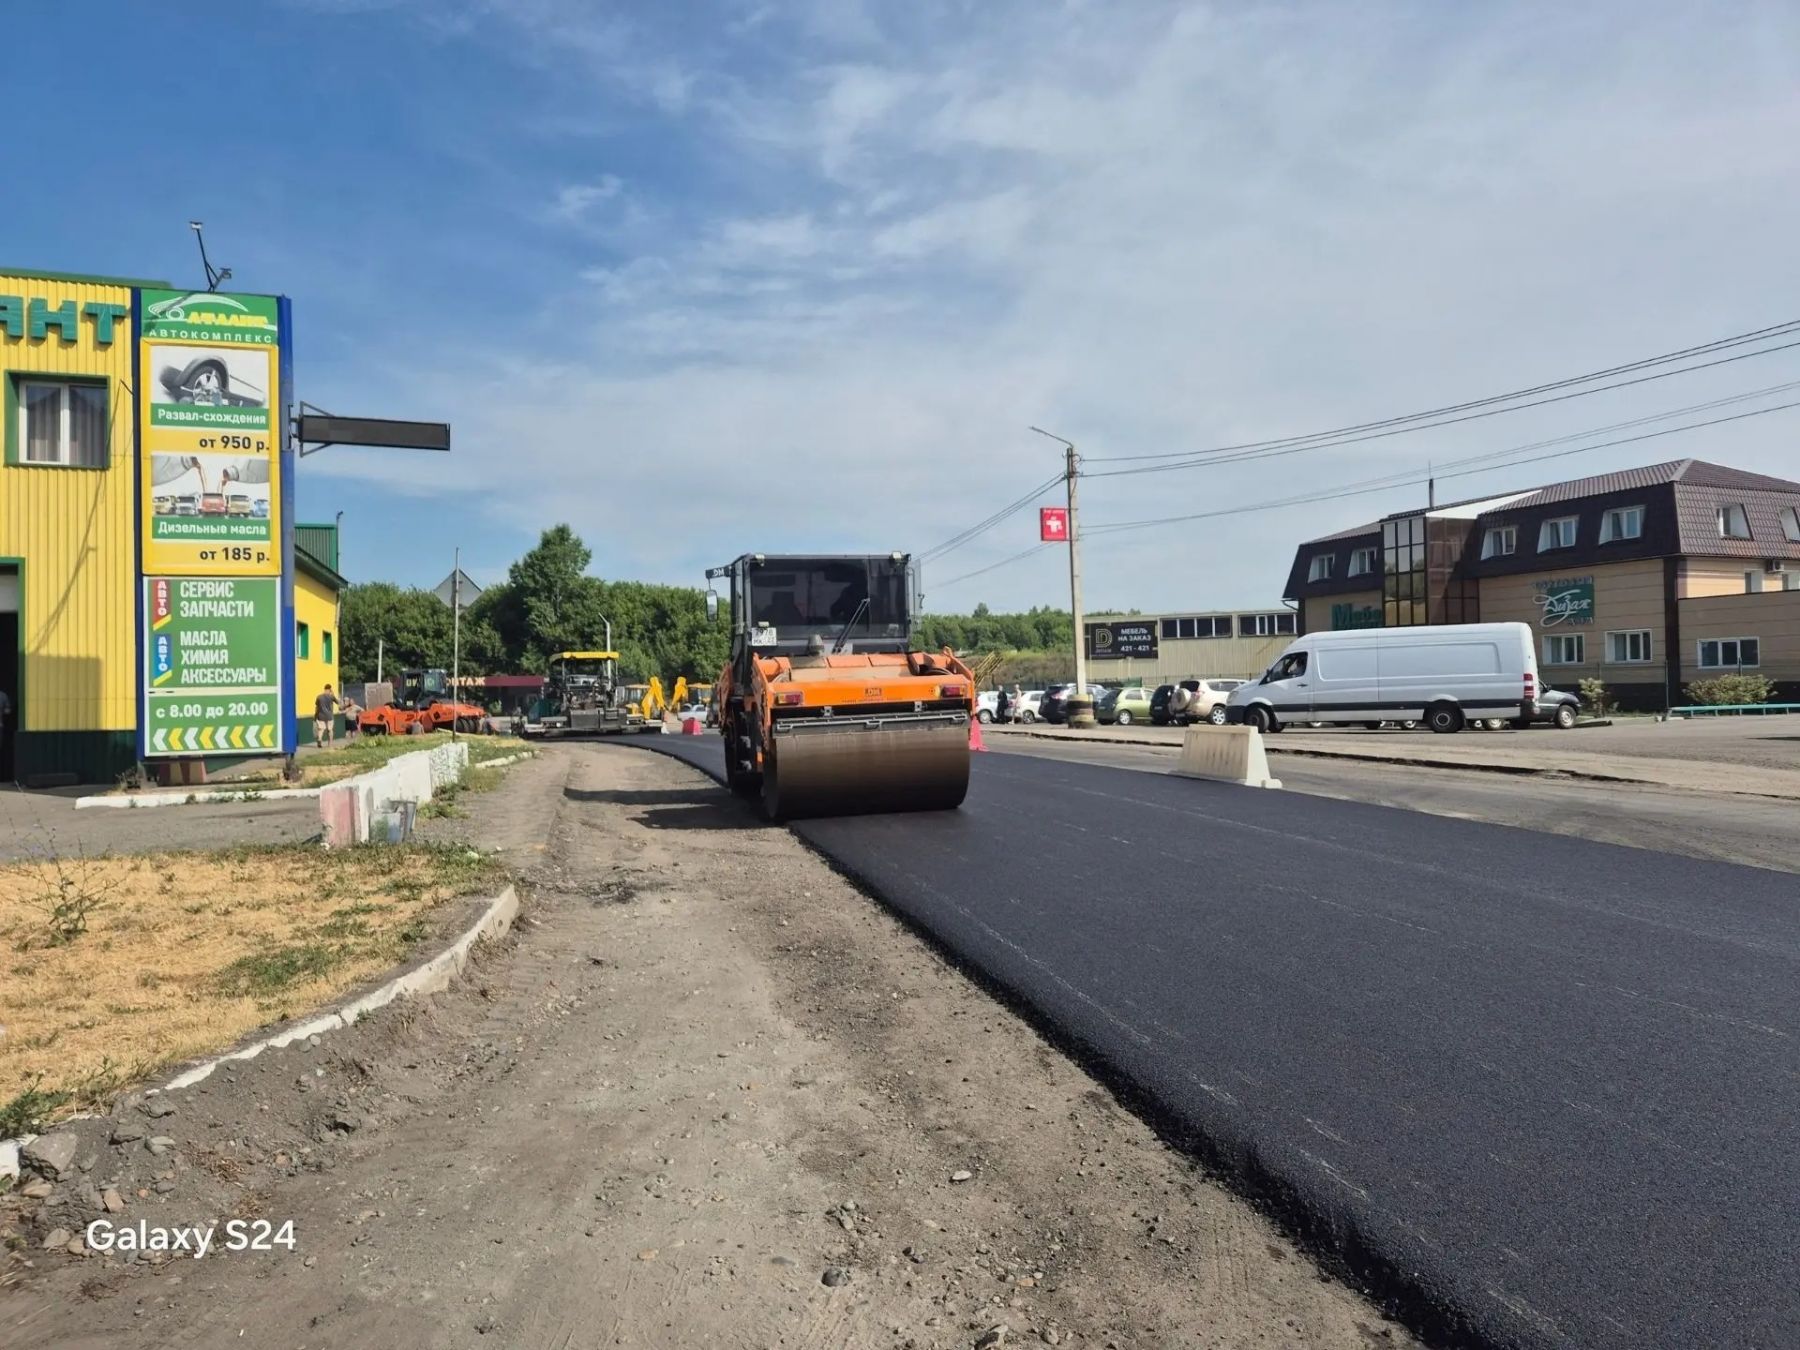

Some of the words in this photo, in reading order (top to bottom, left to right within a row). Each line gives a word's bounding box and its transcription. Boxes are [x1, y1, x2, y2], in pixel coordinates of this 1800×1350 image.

[149, 328, 272, 343] АВТОКОМПЛЕКС
[158, 409, 266, 425] Развал-схождения
[199, 438, 215, 449] от
[221, 435, 251, 450] 950
[256, 440, 270, 452] р.
[158, 522, 228, 536] Дизельные
[230, 524, 267, 536] масла
[200, 551, 217, 561] от
[222, 547, 252, 561] 185
[257, 551, 270, 563] р.
[180, 581, 235, 598] СЕРВИС
[180, 601, 254, 618] ЗАПЧАСТИ
[180, 630, 227, 646] МАСЛА
[1120, 627, 1148, 635] МЕБЕЛЬ
[1129, 634, 1152, 642] ЗАКАЗ
[181, 649, 229, 665] ХИМИЯ
[181, 668, 267, 684] АКСЕССУАРЫ
[156, 707, 165, 718] с
[169, 703, 202, 718] 8.00
[205, 706, 224, 720] до
[228, 701, 269, 717] 20.00
